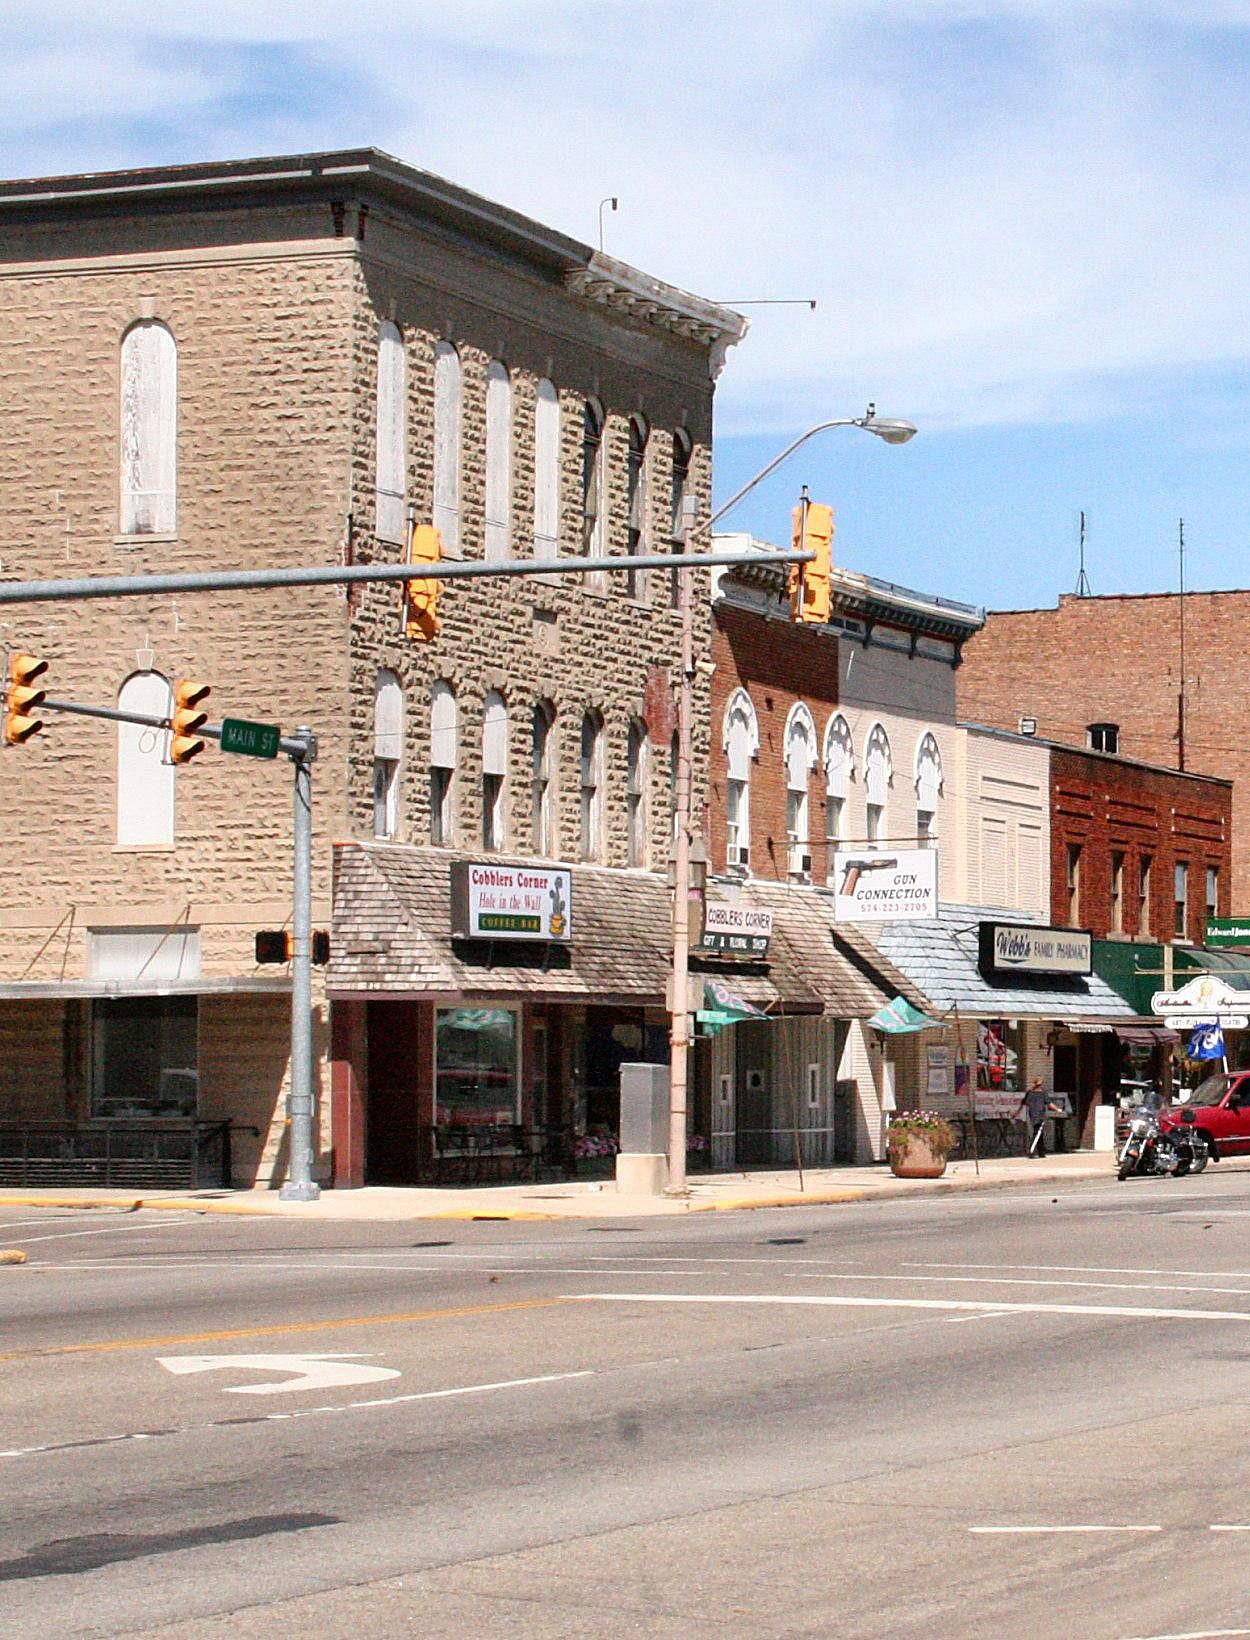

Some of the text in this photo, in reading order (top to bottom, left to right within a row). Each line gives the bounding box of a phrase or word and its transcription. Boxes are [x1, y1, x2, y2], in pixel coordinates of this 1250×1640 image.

[227, 727, 276, 750] MAIN ST
[472, 869, 549, 889] Cobblers Corner
[893, 873, 918, 886] GUN
[479, 892, 541, 911] Hole in the Wall
[856, 887, 932, 901] CONNECTION
[482, 917, 516, 928] COFFEE
[708, 907, 771, 931] COBBLERS CORNER
[1207, 926, 1235, 937] Edward
[997, 930, 1032, 958] Webb's
[1056, 943, 1089, 960] PHARMACY
